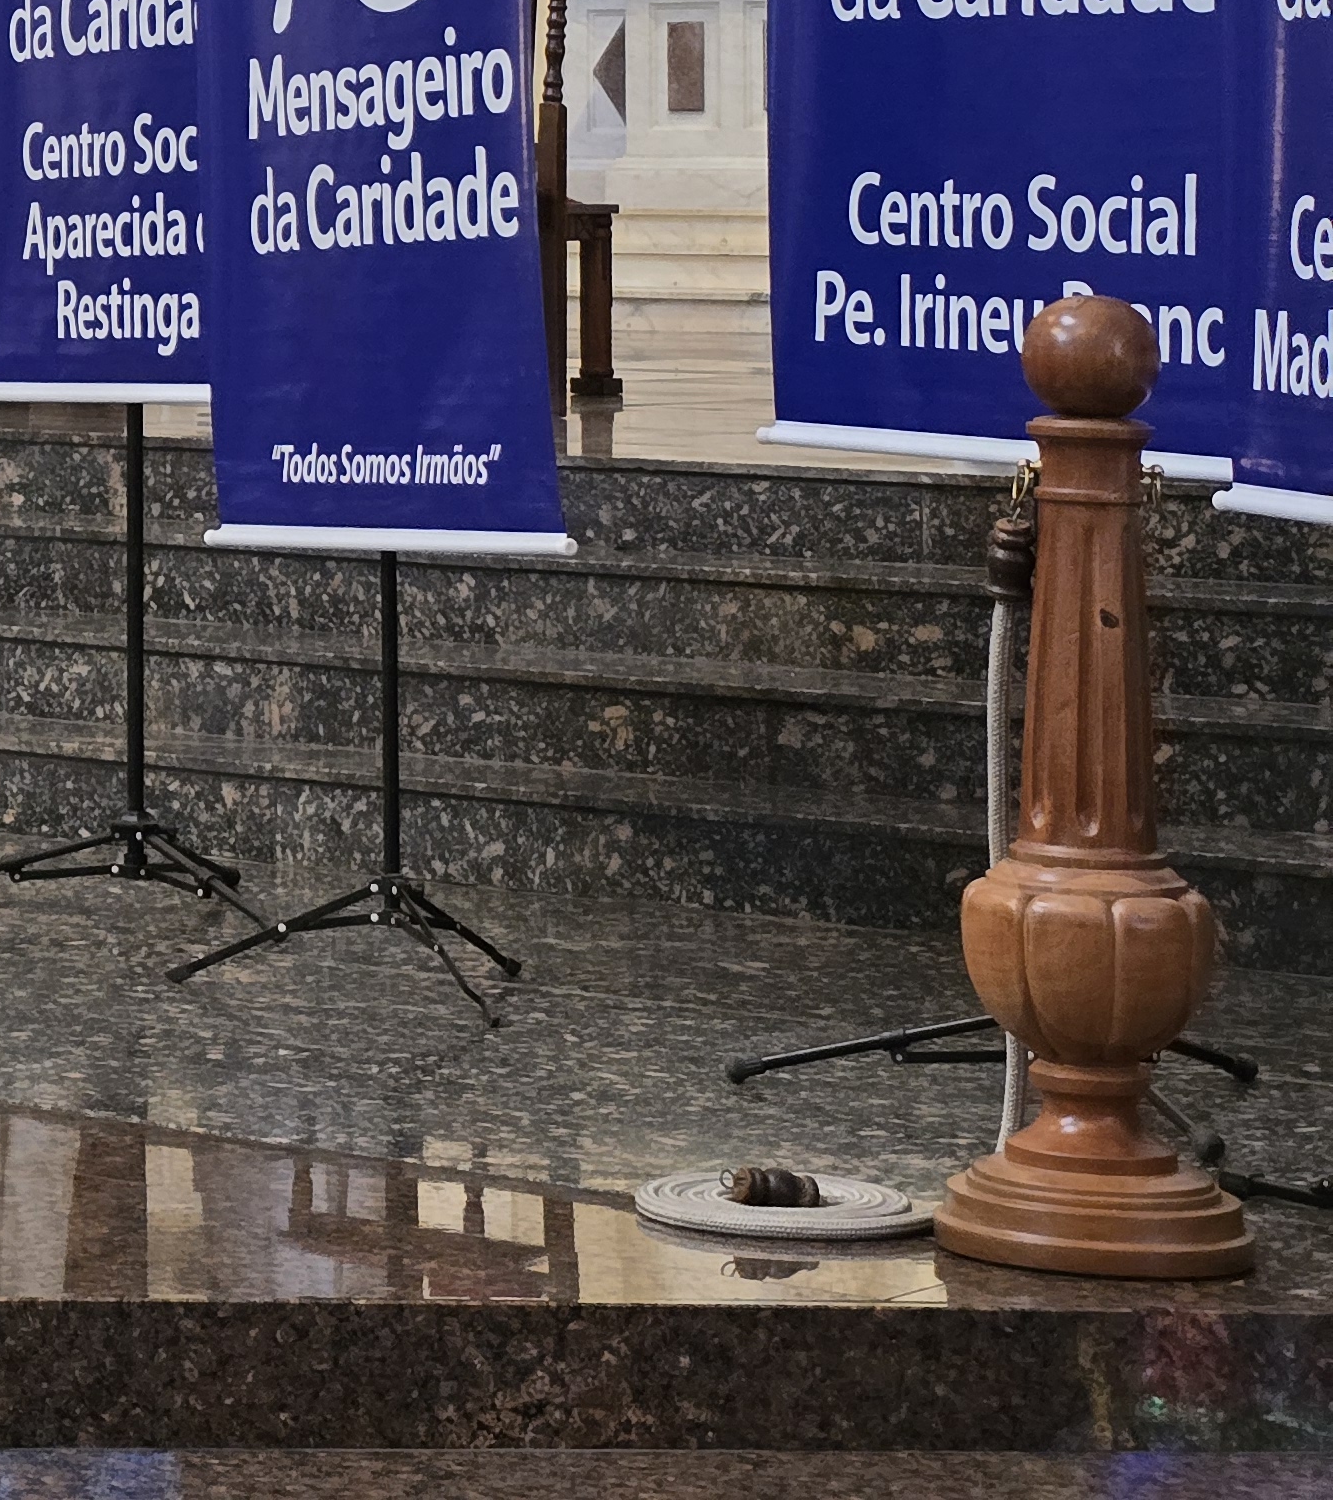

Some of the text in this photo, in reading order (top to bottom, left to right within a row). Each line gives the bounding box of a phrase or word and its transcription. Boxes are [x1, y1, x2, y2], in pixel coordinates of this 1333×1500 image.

[249, 27, 513, 150] Mensageiro
[23, 113, 198, 180] Centro Soc
[23, 192, 186, 275] Aparecida
[251, 167, 300, 254] da
[307, 146, 520, 250] Caridade
[849, 172, 1197, 256] Centro Social
[58, 278, 199, 357] Restinga
[815, 271, 885, 346] Pe.
[340, 443, 411, 485] Somos
